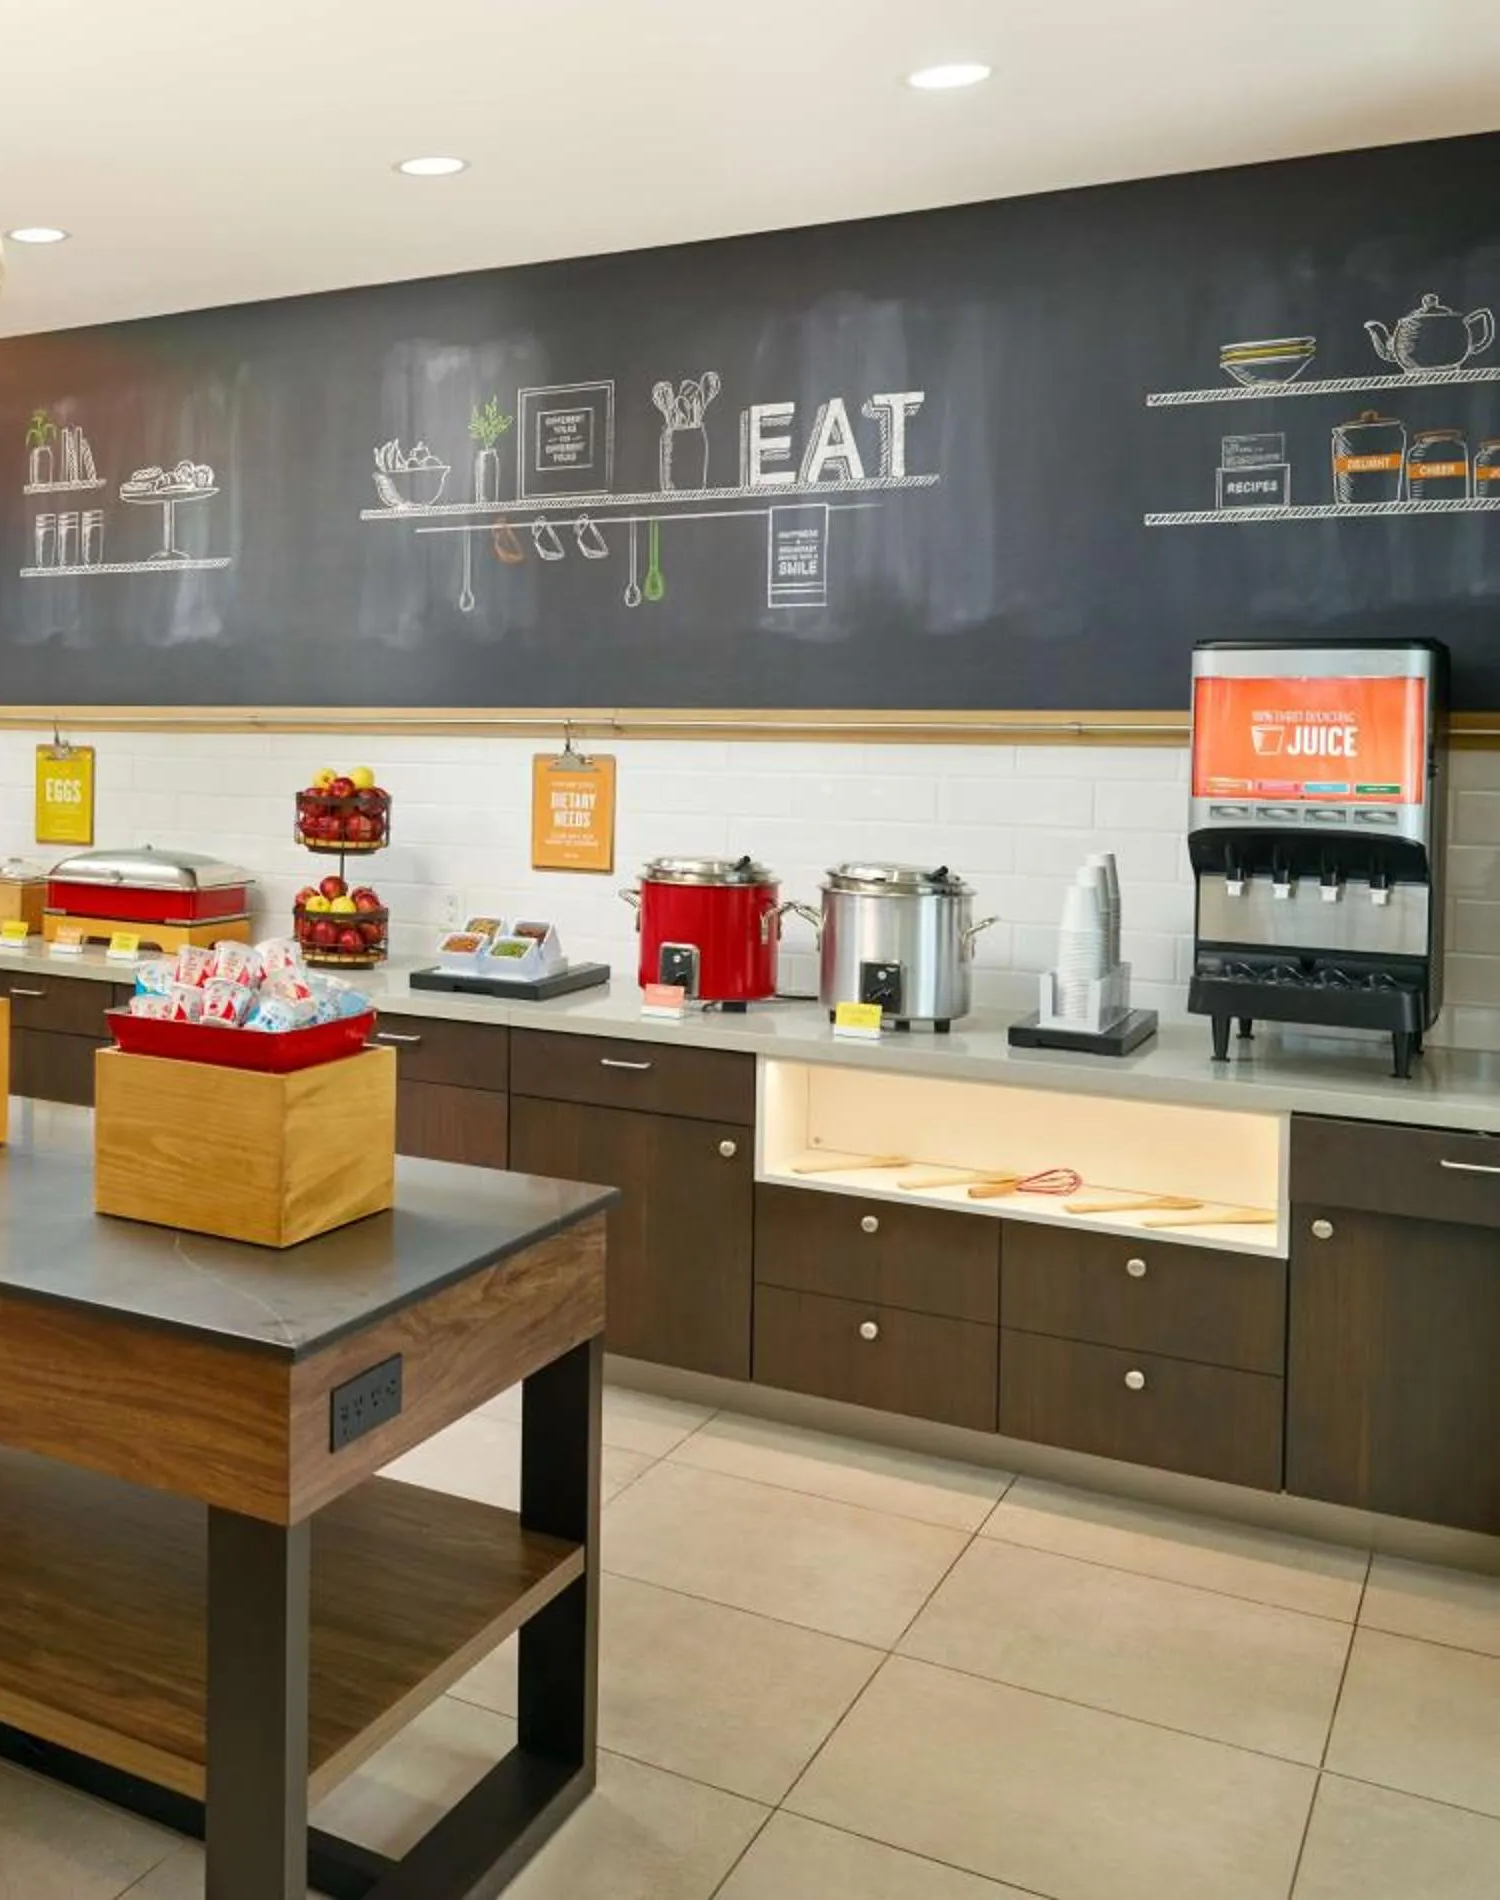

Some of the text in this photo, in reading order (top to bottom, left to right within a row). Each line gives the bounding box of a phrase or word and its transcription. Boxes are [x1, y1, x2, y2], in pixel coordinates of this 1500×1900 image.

[740, 391, 925, 487] EAT
[1227, 480, 1278, 494] RECIPES
[779, 561, 817, 575] SMILE
[1287, 725, 1358, 757] JUICE
[45, 777, 82, 803] EGGS
[550, 792, 596, 810] DIETARY
[553, 811, 591, 828] NEEDS
